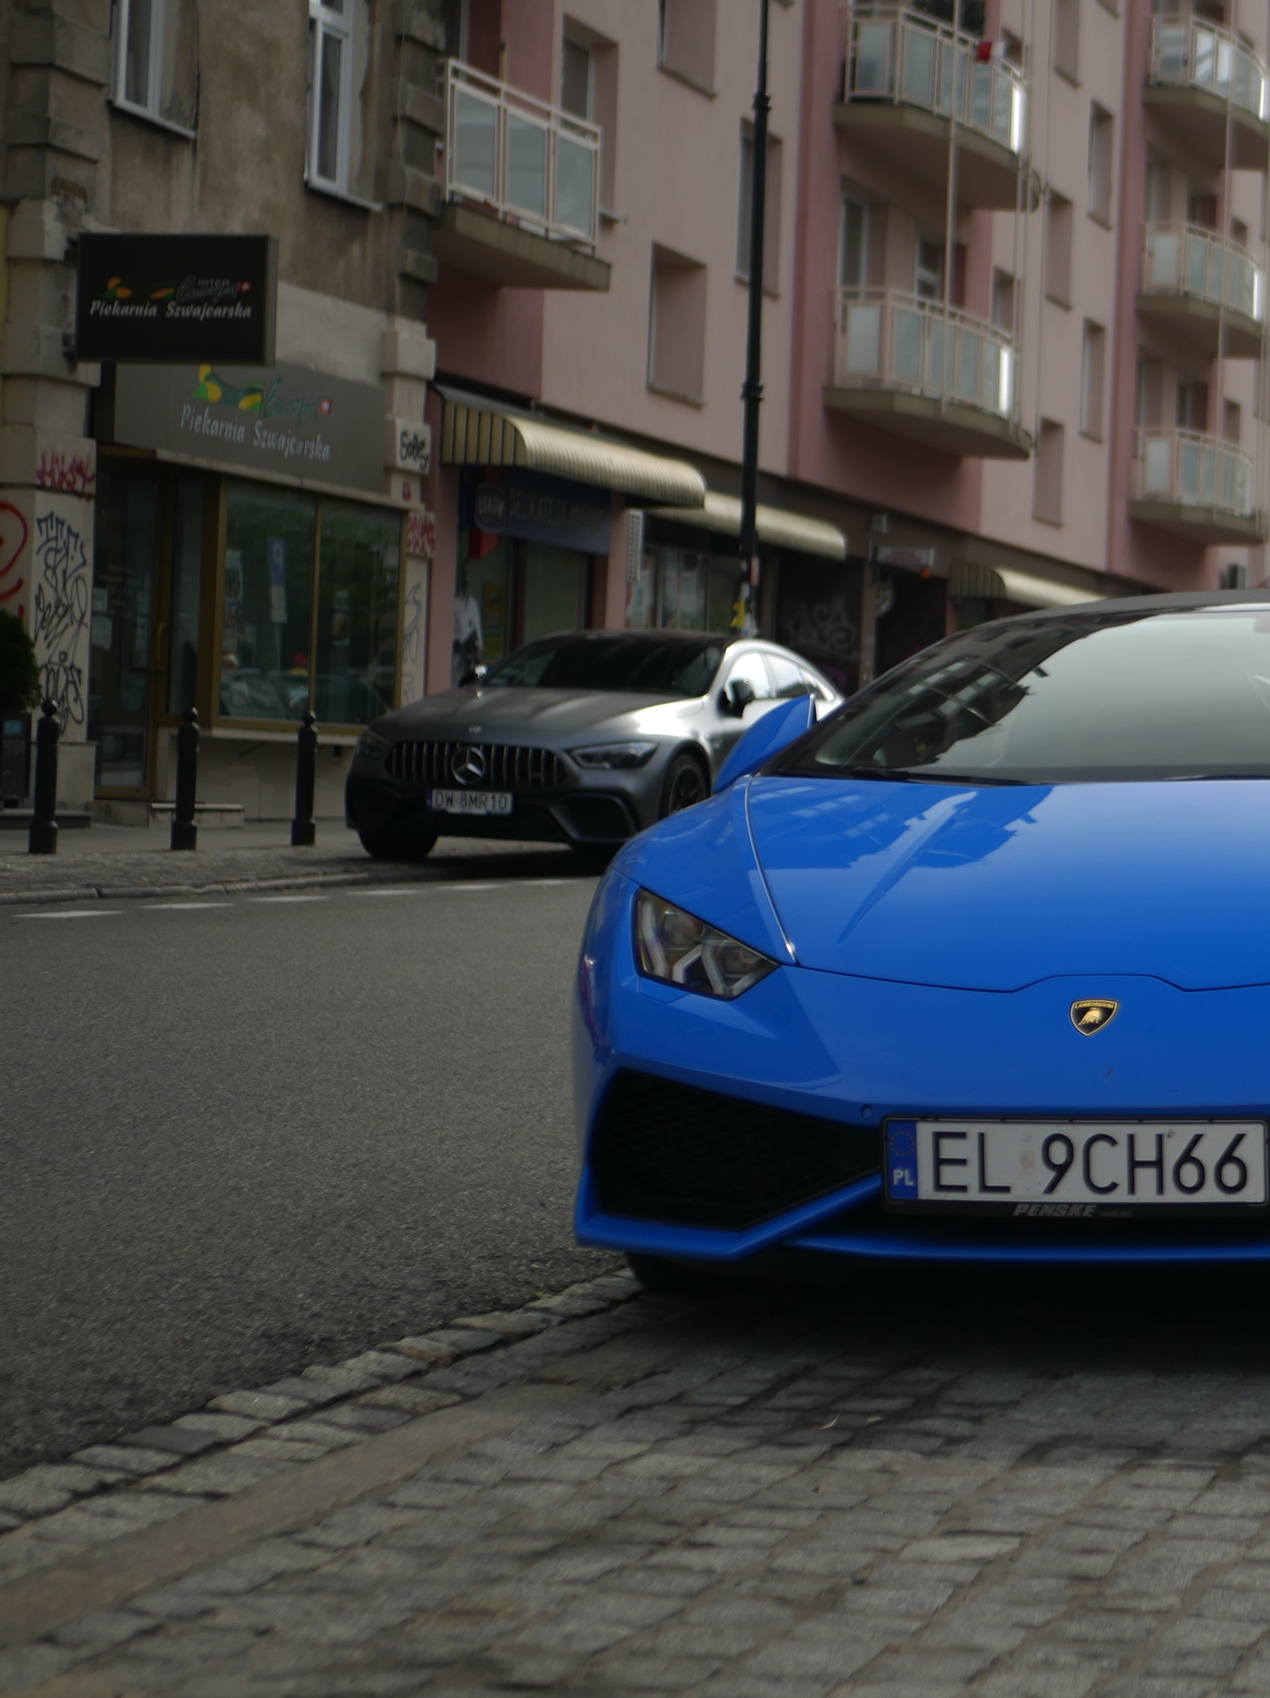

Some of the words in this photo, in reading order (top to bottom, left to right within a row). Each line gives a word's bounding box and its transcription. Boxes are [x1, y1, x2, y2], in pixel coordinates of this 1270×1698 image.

[89, 300, 157, 317] Piekarnia
[165, 301, 252, 321] Szwajcarska
[180, 402, 246, 444] Piekarnia
[252, 418, 332, 462] Szwajcarska
[434, 790, 453, 807] DW
[459, 792, 507, 812] 8MR10
[931, 1131, 1011, 1194] EL
[1041, 1132, 1248, 1195] 9CH66
[893, 1169, 914, 1186] PL
[1012, 1203, 1097, 1218] PENSKE
